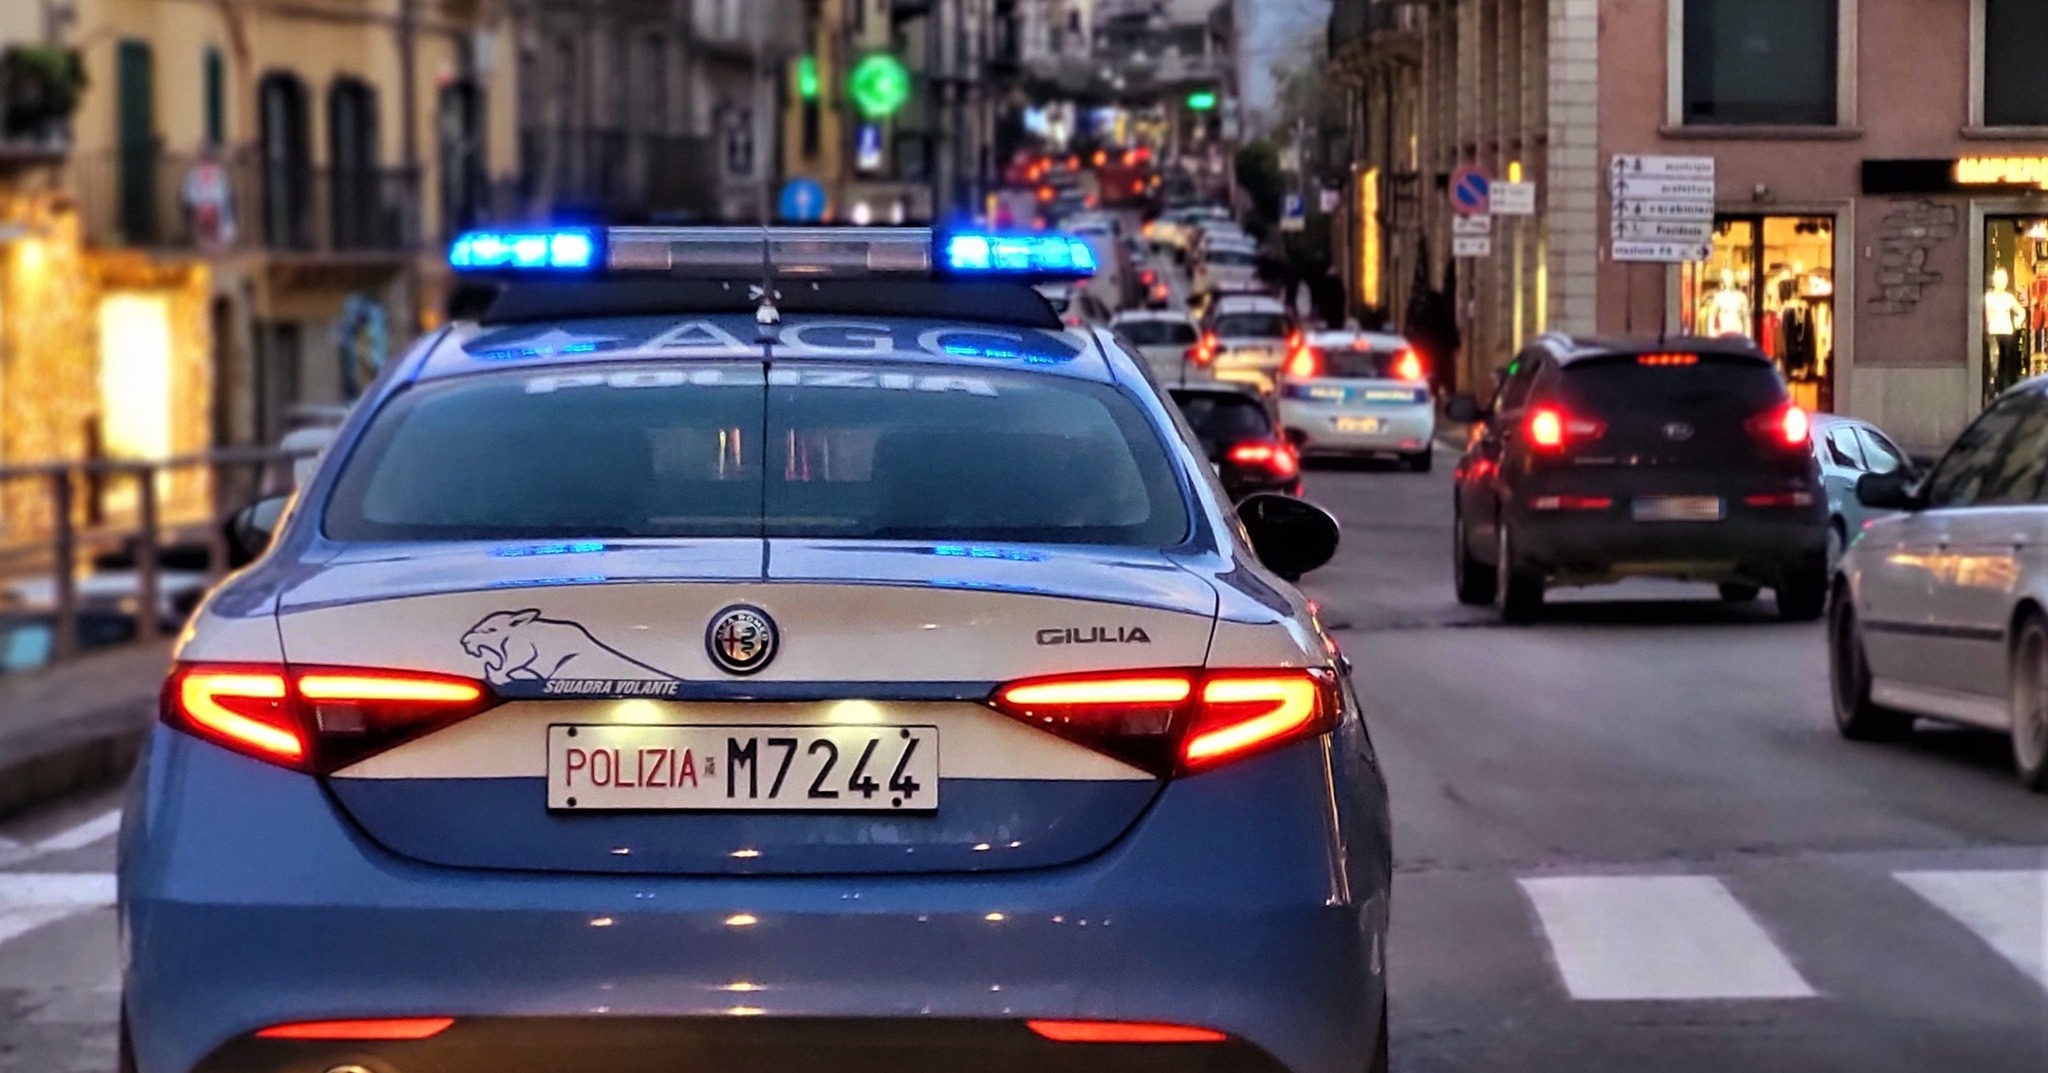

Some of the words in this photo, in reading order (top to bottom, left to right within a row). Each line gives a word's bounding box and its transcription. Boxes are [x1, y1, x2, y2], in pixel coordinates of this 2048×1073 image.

[1649, 204, 1714, 214] carabinieri
[525, 369, 998, 398] POLIZIA
[738, 613, 769, 642] ROMEO
[1036, 626, 1152, 646] GIULIA
[543, 680, 612, 695] SQUADRA
[614, 680, 680, 696] VOLANTE
[565, 748, 699, 788] POLIZIA
[726, 737, 921, 799] M7244
